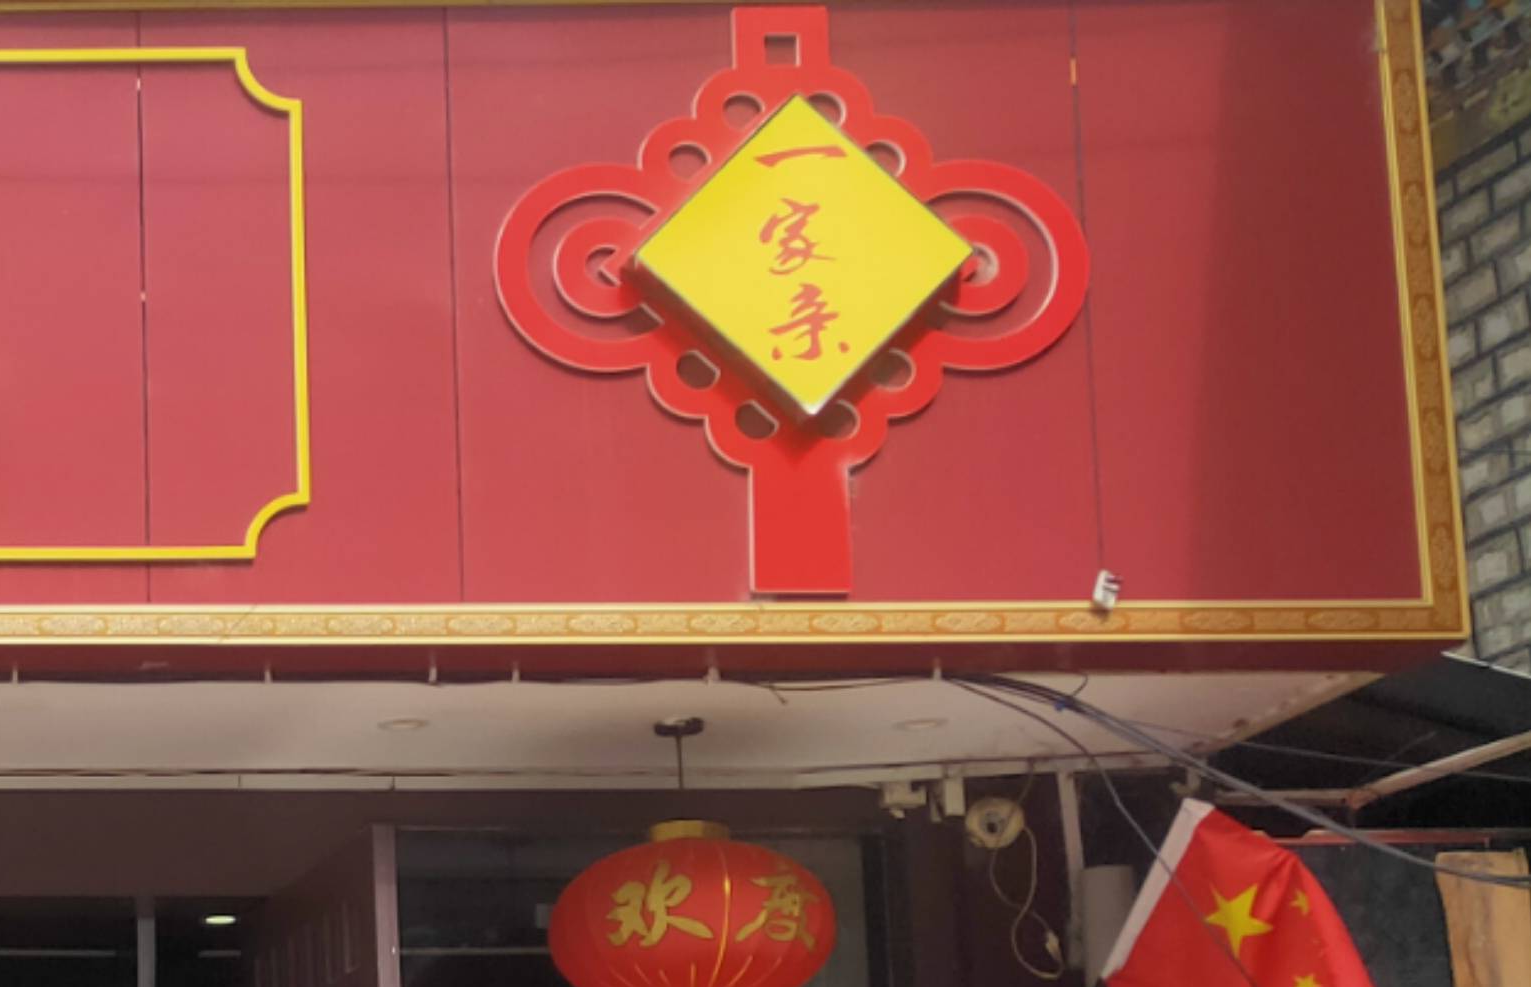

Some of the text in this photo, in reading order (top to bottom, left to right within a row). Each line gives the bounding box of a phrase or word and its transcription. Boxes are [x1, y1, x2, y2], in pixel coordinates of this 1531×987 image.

[751, 142, 850, 364] 一家亲
[605, 860, 817, 951] 欢度
